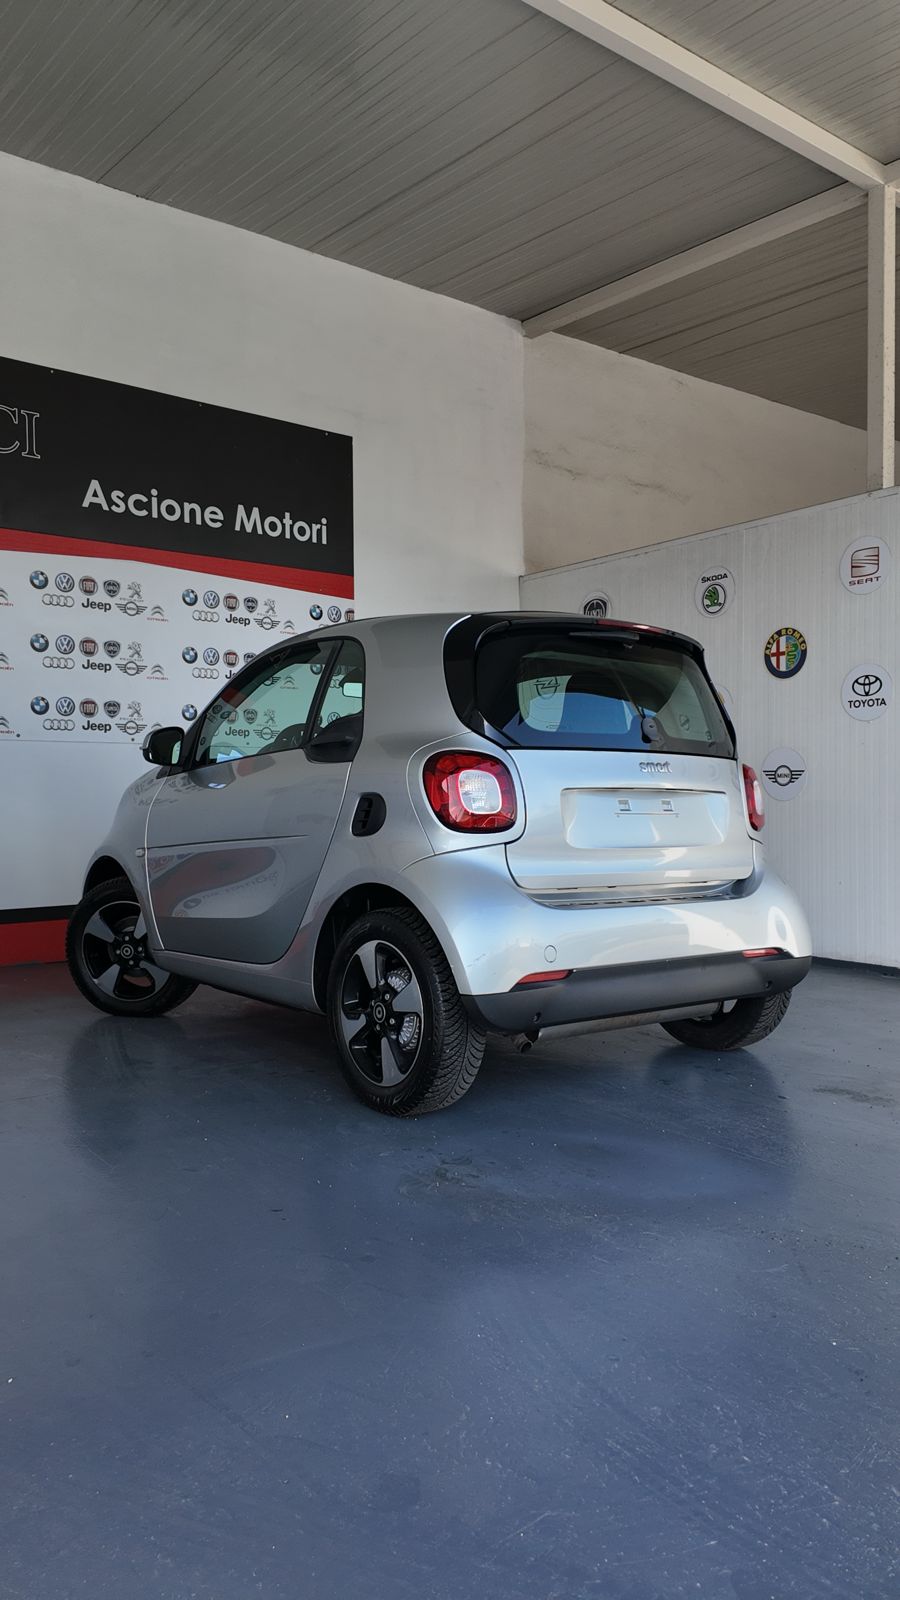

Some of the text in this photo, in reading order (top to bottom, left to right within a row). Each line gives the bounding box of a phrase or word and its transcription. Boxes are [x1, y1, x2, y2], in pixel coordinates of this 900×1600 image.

[82, 479, 328, 545] Ascione Motori
[849, 576, 881, 586] SEAT
[82, 598, 111, 613] Jeep
[225, 614, 251, 627] Jeep
[781, 628, 807, 651] ROMEO
[82, 659, 111, 673] Jeep
[848, 698, 887, 708] TOYOTA
[82, 720, 111, 733] Jeep
[225, 727, 251, 739] Jeep
[639, 761, 673, 773] smart
